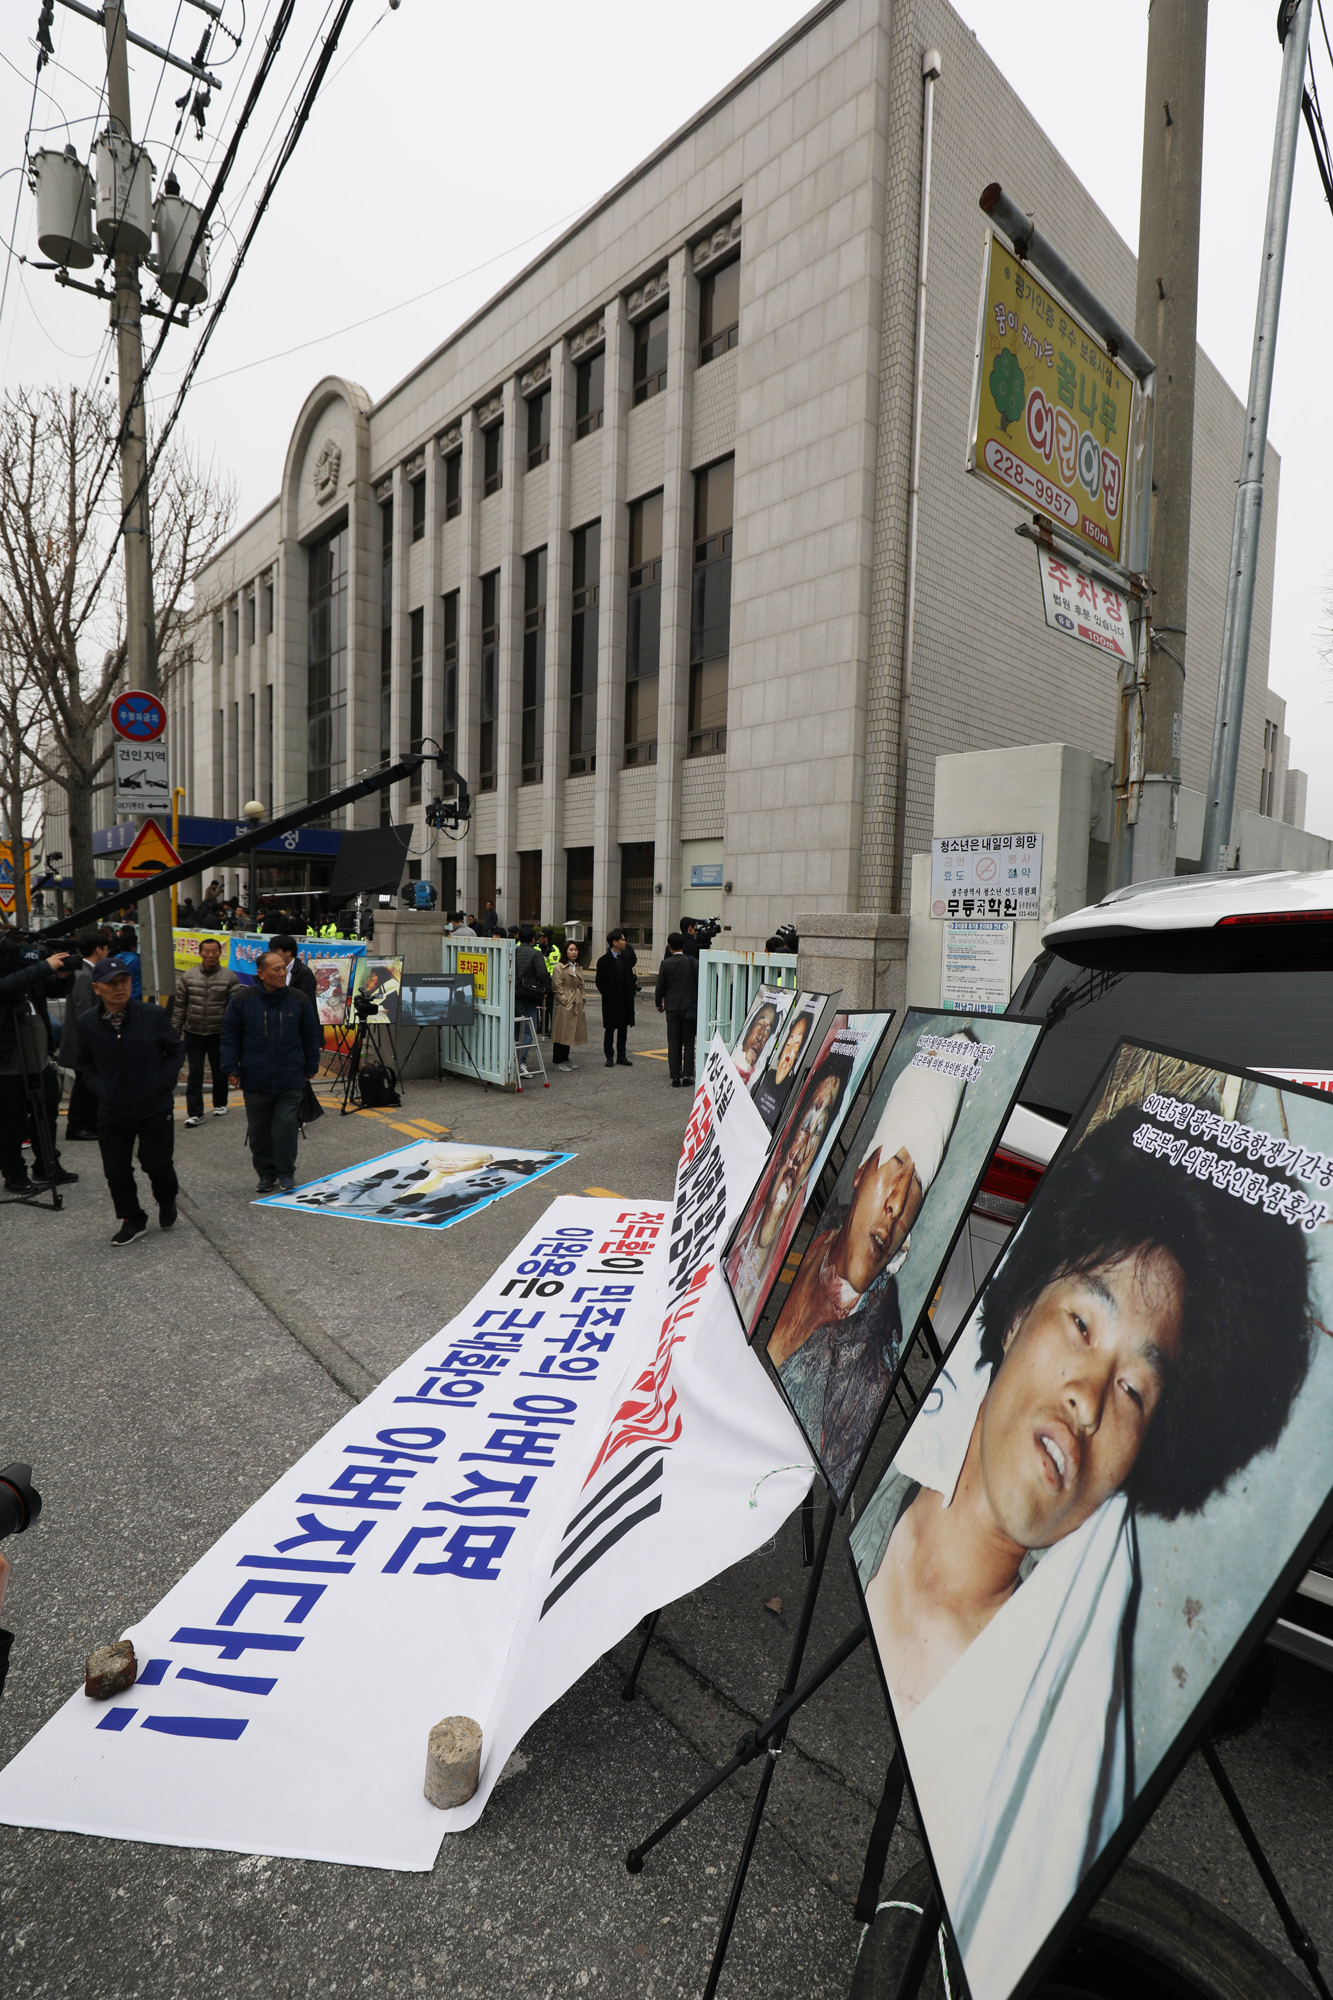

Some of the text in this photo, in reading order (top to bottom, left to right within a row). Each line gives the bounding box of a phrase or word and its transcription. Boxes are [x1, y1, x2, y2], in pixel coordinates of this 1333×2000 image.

[994, 303, 1055, 368] 꿈이 커가는
[1015, 272, 1113, 384] 평가인증 우수 보육시설
[1056, 350, 1117, 443] 꿈나무
[1026, 386, 1122, 521] 어린이집
[992, 449, 1071, 517] 228-9957
[1084, 519, 1109, 547] 150m
[1048, 556, 1122, 622] 주차장
[1053, 593, 1125, 639] 법원 후문 있습니다
[1058, 615, 1072, 629] 유료
[1087, 630, 1115, 651] 100m
[119, 710, 159, 723] 주정차금지
[118, 749, 166, 763] 견인지역
[117, 800, 145, 810] 여기부터
[940, 834, 1038, 853] 청소년은 내일의 희망
[951, 886, 1037, 897] 광주광역시 청소년 선도위원회
[460, 960, 485, 976] 주차금지
[1132, 1125, 1327, 1231] 신군부에 의한 잔인한 참혹상
[498, 1226, 596, 1300] 이완용은
[392, 1307, 547, 1409] 근대화의
[381, 1210, 665, 1581] 전두환이 민주주의 아버지면
